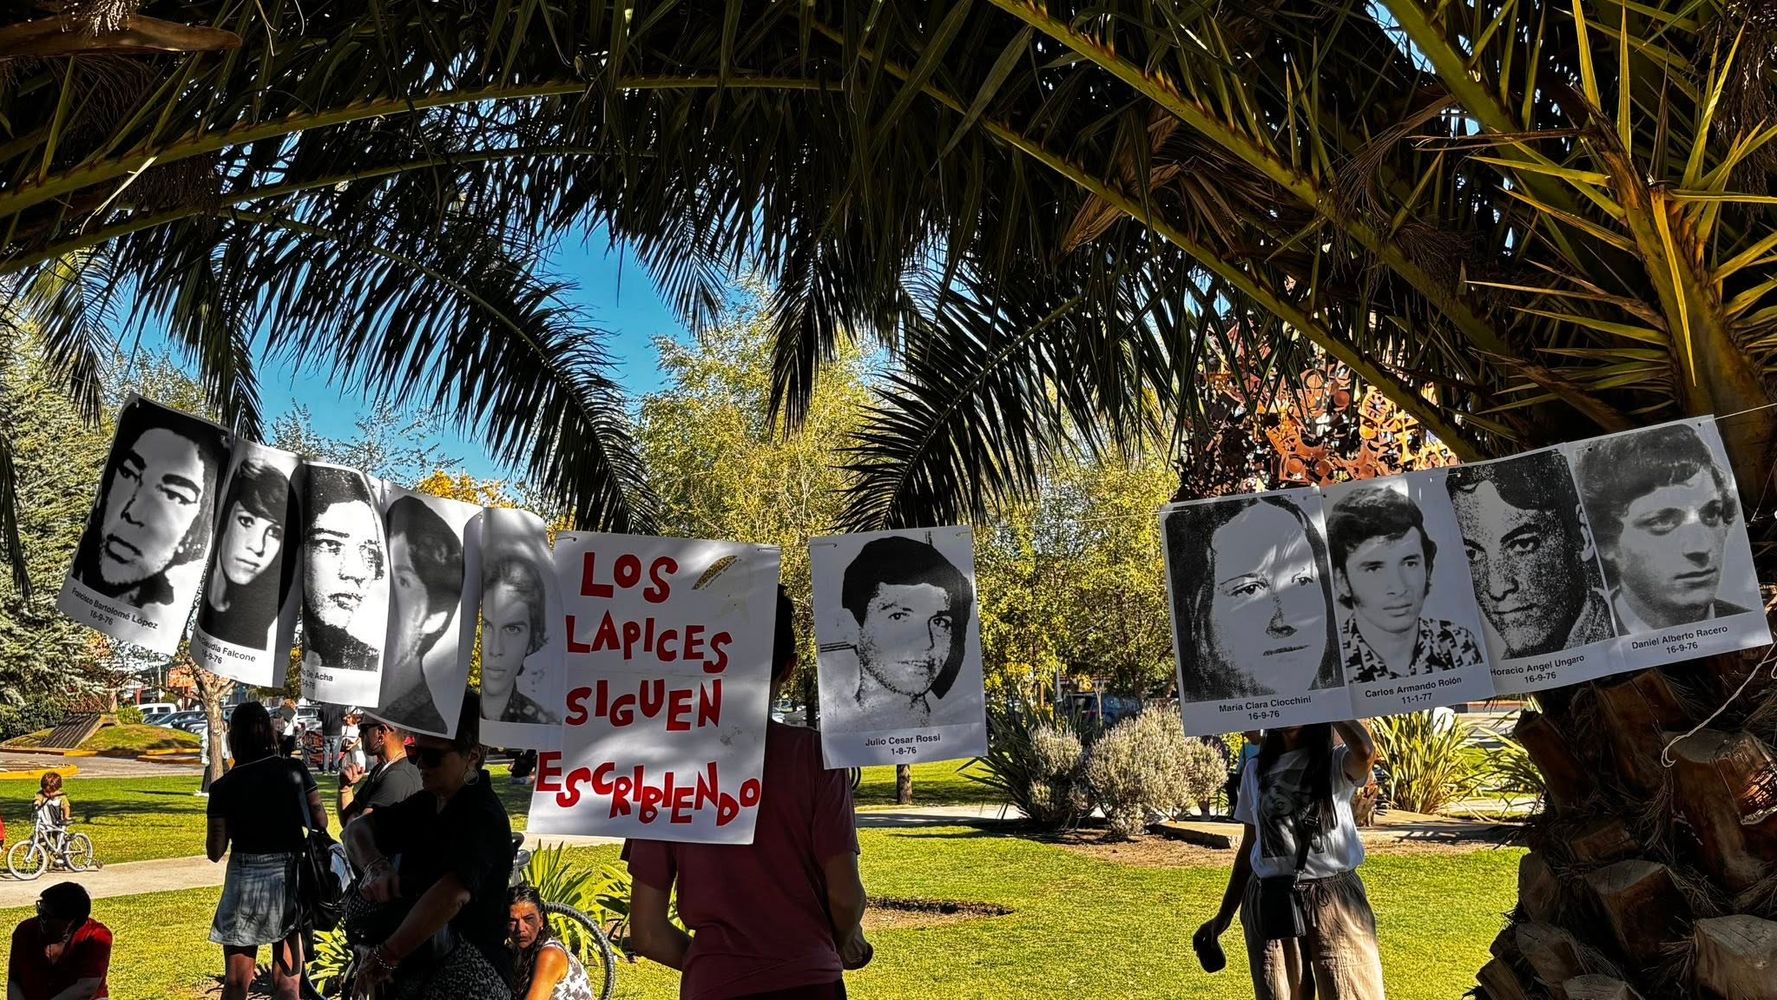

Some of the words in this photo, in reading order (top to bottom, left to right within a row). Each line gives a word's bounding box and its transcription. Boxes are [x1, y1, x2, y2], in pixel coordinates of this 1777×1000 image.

[580, 552, 678, 603] LOS
[90, 610, 114, 626] 16-9-76
[94, 600, 130, 620] Bartolomé
[132, 614, 158, 629] López
[565, 609, 733, 674] LAPICES
[1632, 638, 1660, 650] Daniel
[1662, 632, 1694, 644] Alberto
[1696, 626, 1728, 638] Racero
[222, 647, 256, 662] Falcone
[1666, 642, 1698, 654] 16-9-76
[1490, 666, 1524, 676] Horacio
[1526, 661, 1552, 672] Angel
[1554, 655, 1584, 667] Ungaro
[314, 672, 334, 682] Acha
[1524, 672, 1556, 684] 16-9-76
[1365, 688, 1394, 698] Carlos
[1396, 682, 1436, 694] Armando
[1438, 676, 1462, 688] Rolón
[565, 679, 722, 731] SIGUEN
[1246, 701, 1268, 710] Clara
[1270, 695, 1312, 708] Ciocchini
[1402, 692, 1432, 704] 11-1-77
[1248, 710, 1280, 720] 16-9-76
[865, 737, 886, 746] Julio
[888, 736, 914, 745] Cesar
[916, 734, 941, 743] Rossi
[891, 746, 917, 756] 1-8-76
[536, 751, 760, 827] ESCRIBIENDO
